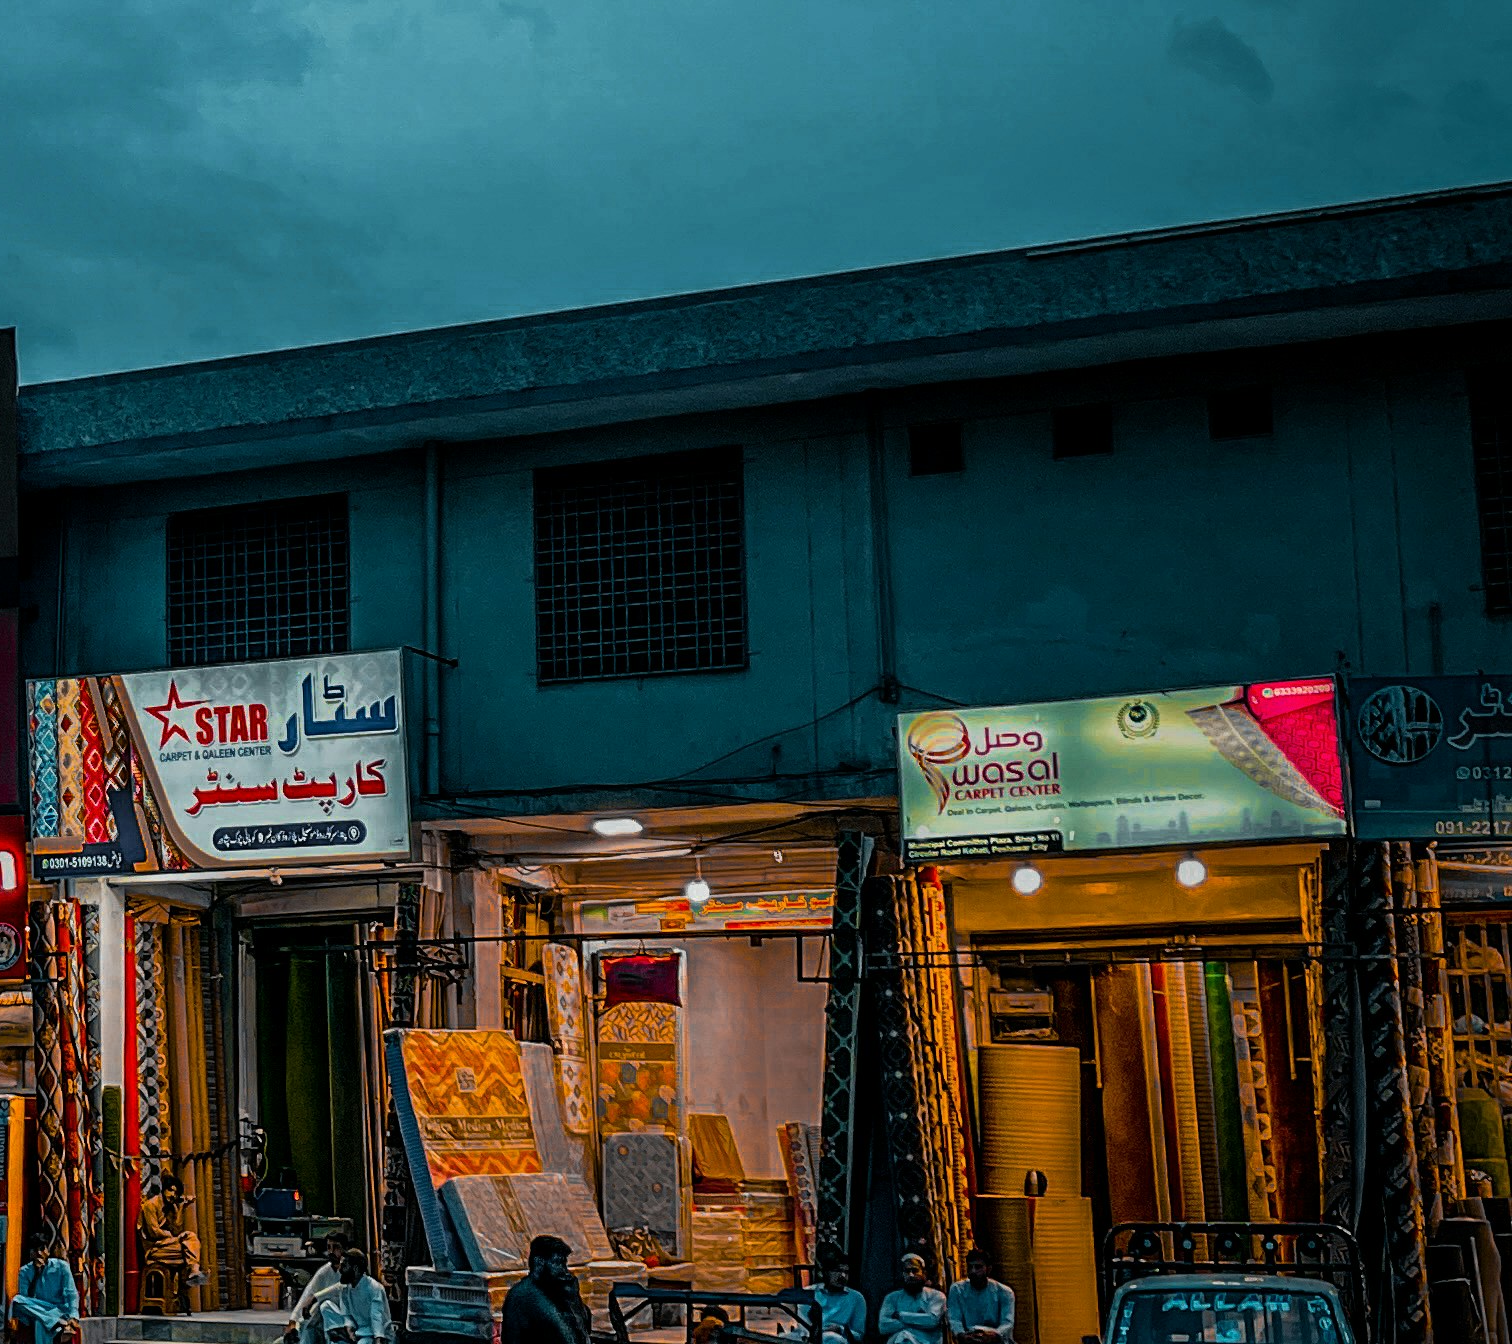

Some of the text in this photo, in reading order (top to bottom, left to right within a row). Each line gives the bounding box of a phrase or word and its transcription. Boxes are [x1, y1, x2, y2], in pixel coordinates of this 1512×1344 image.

[195, 703, 268, 747] STAR
[277, 672, 399, 754] سٹار
[159, 750, 192, 763] CARPET
[202, 748, 236, 760] QALEEN
[238, 746, 272, 757] CENTER
[974, 727, 1043, 755] وصل
[186, 759, 388, 816] کارپٹ سنٹر
[954, 783, 1062, 801] CARPET CENTER
[1162, 1292, 1292, 1312] ALLAH
